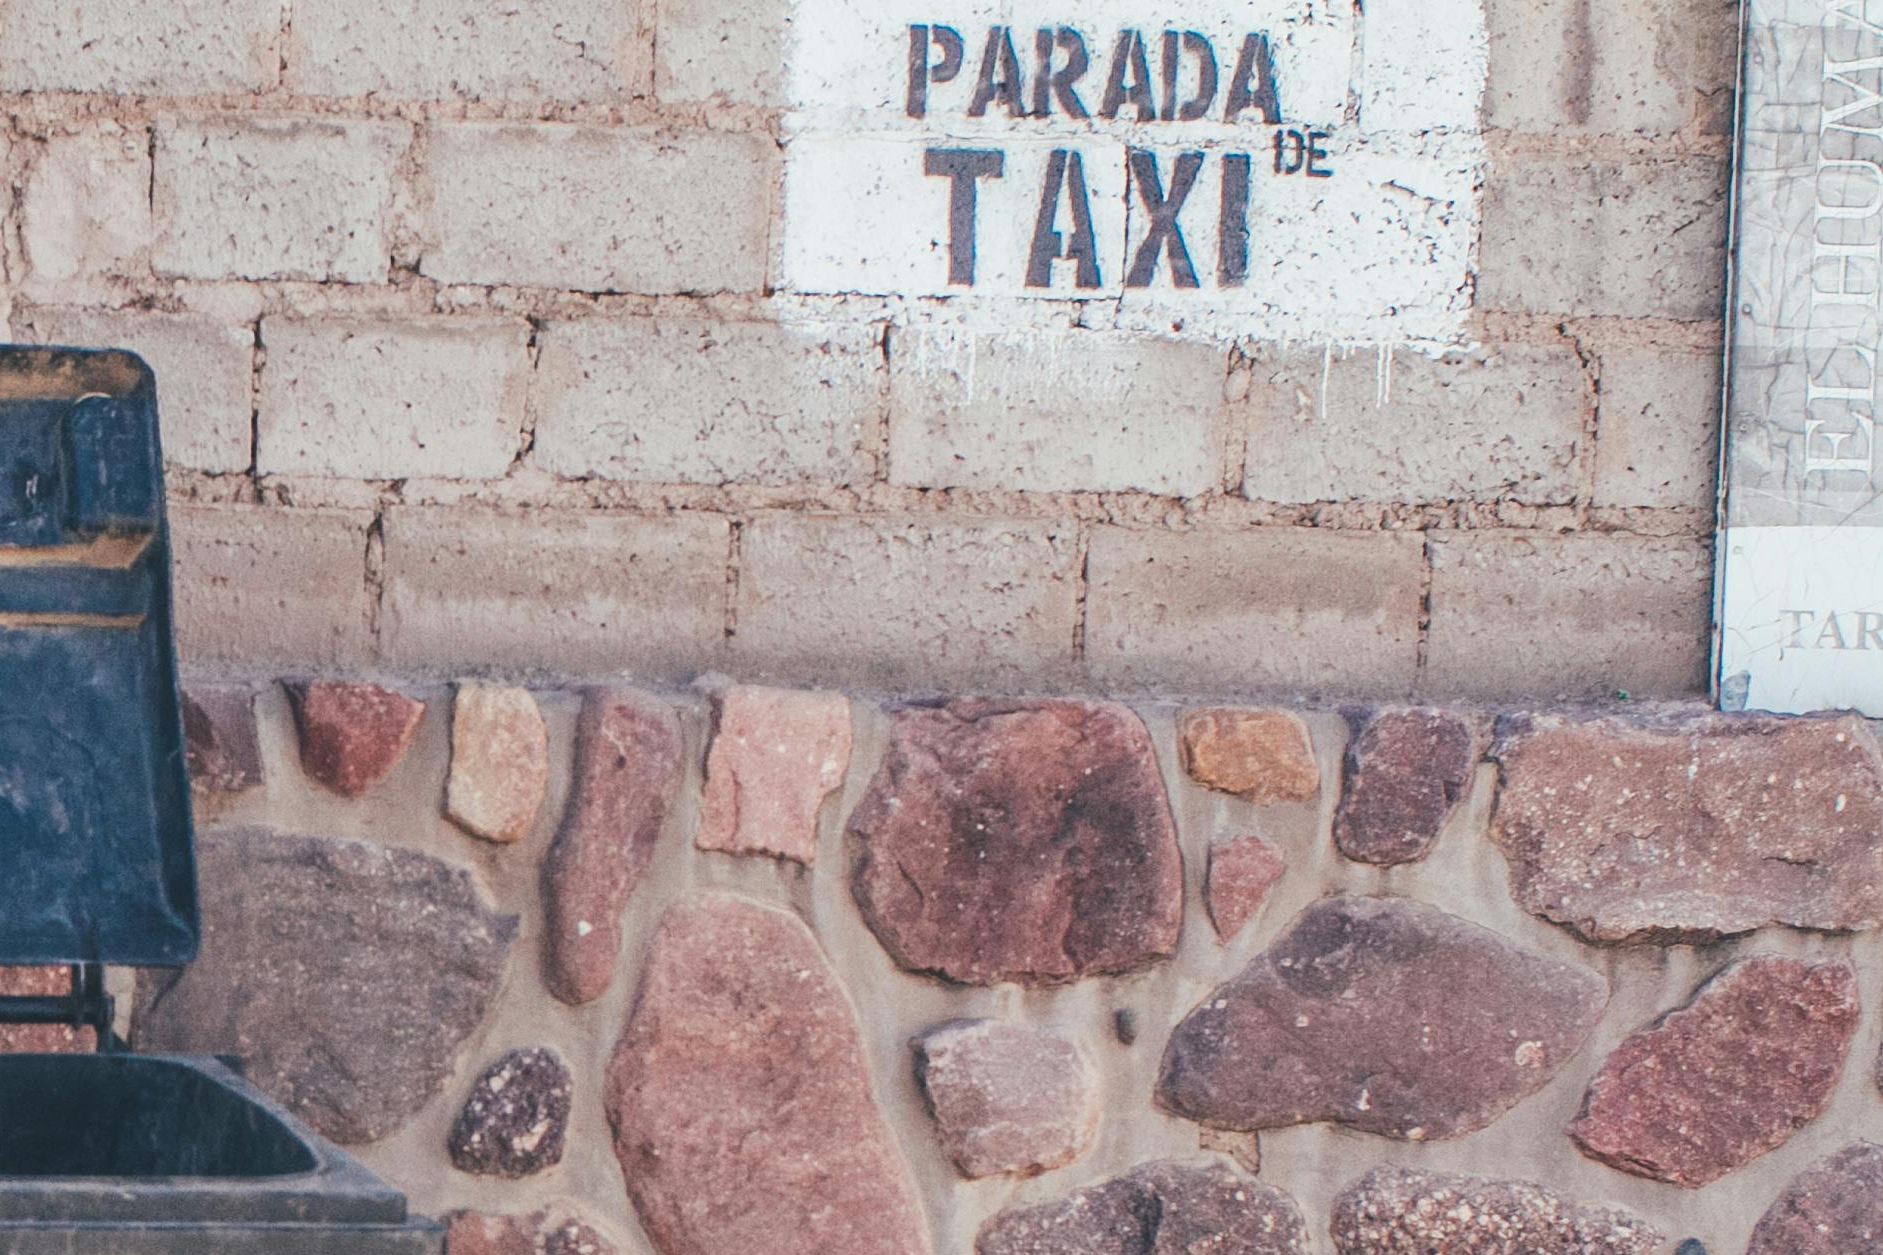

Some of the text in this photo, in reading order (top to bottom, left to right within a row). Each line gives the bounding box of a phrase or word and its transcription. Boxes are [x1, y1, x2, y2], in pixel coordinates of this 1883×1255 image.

[906, 25, 1280, 124] PARADA
[1274, 131, 1333, 177] DE
[924, 149, 1250, 288] TAXI
[1805, 344, 1875, 474] EL
[1778, 608, 1883, 650] TAR
